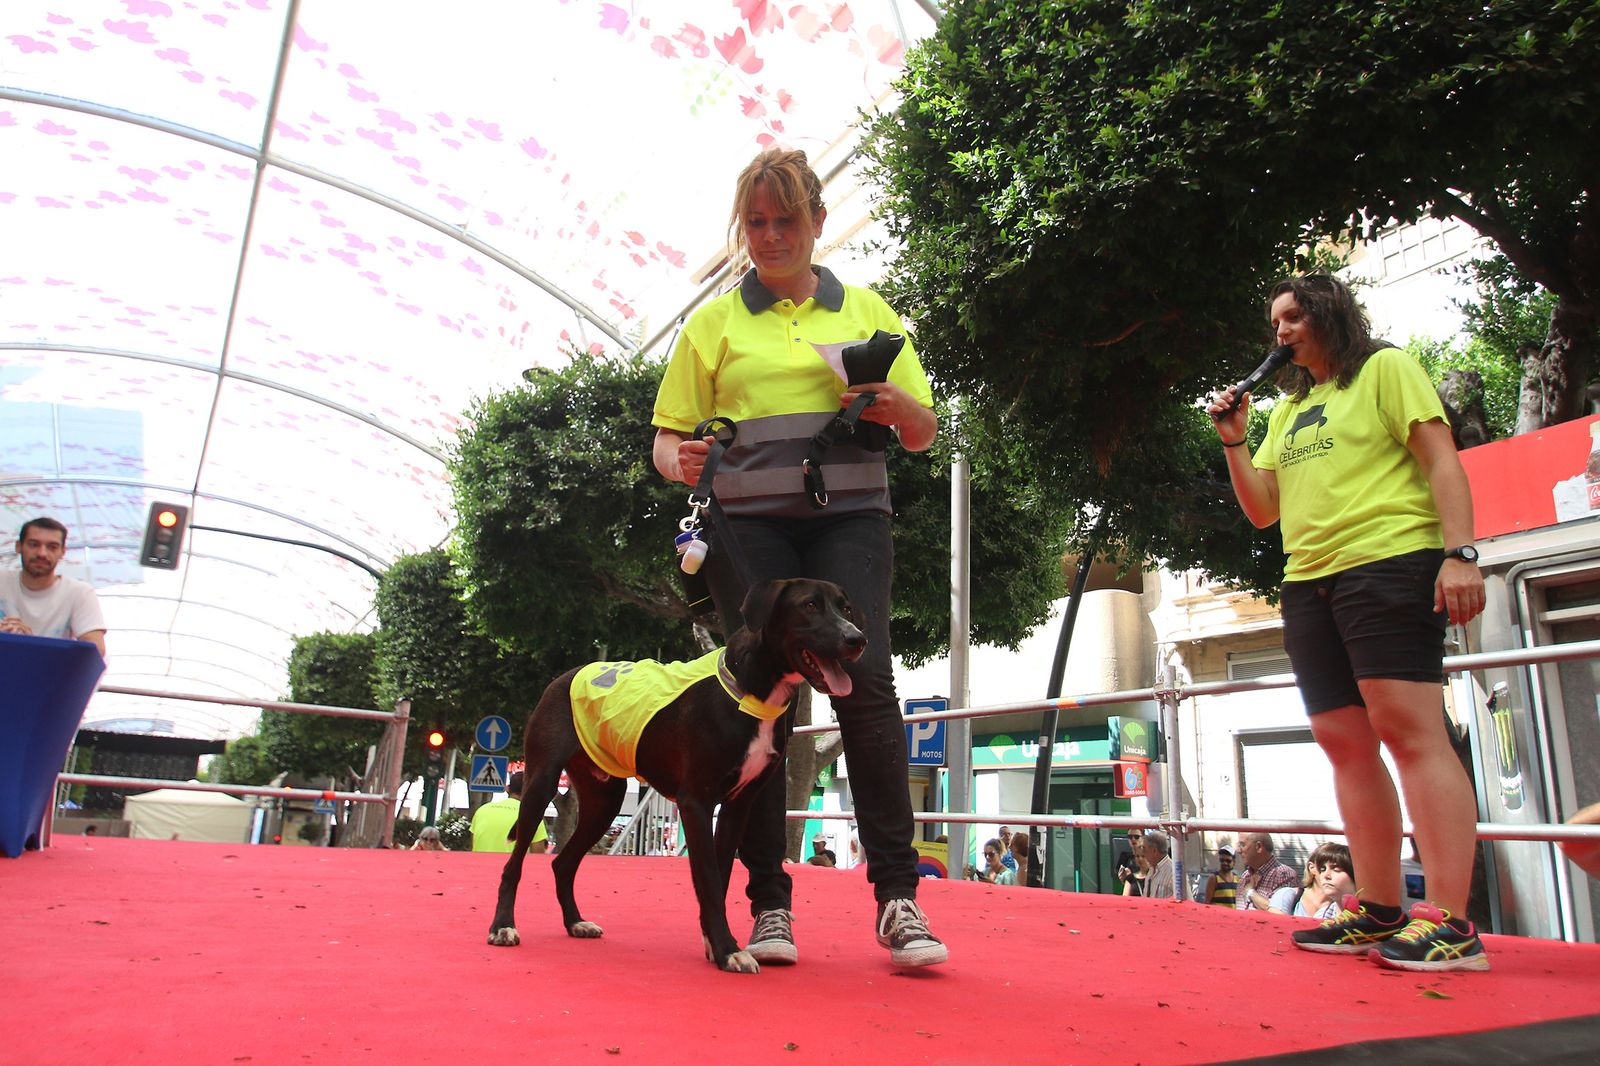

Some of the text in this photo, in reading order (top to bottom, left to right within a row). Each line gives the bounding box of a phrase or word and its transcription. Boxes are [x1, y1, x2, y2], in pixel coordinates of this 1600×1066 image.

[911, 706, 938, 758] P
[921, 750, 943, 759] MOTOS
[1021, 734, 1080, 760] Uaja
[1123, 745, 1147, 756] Unicaja
